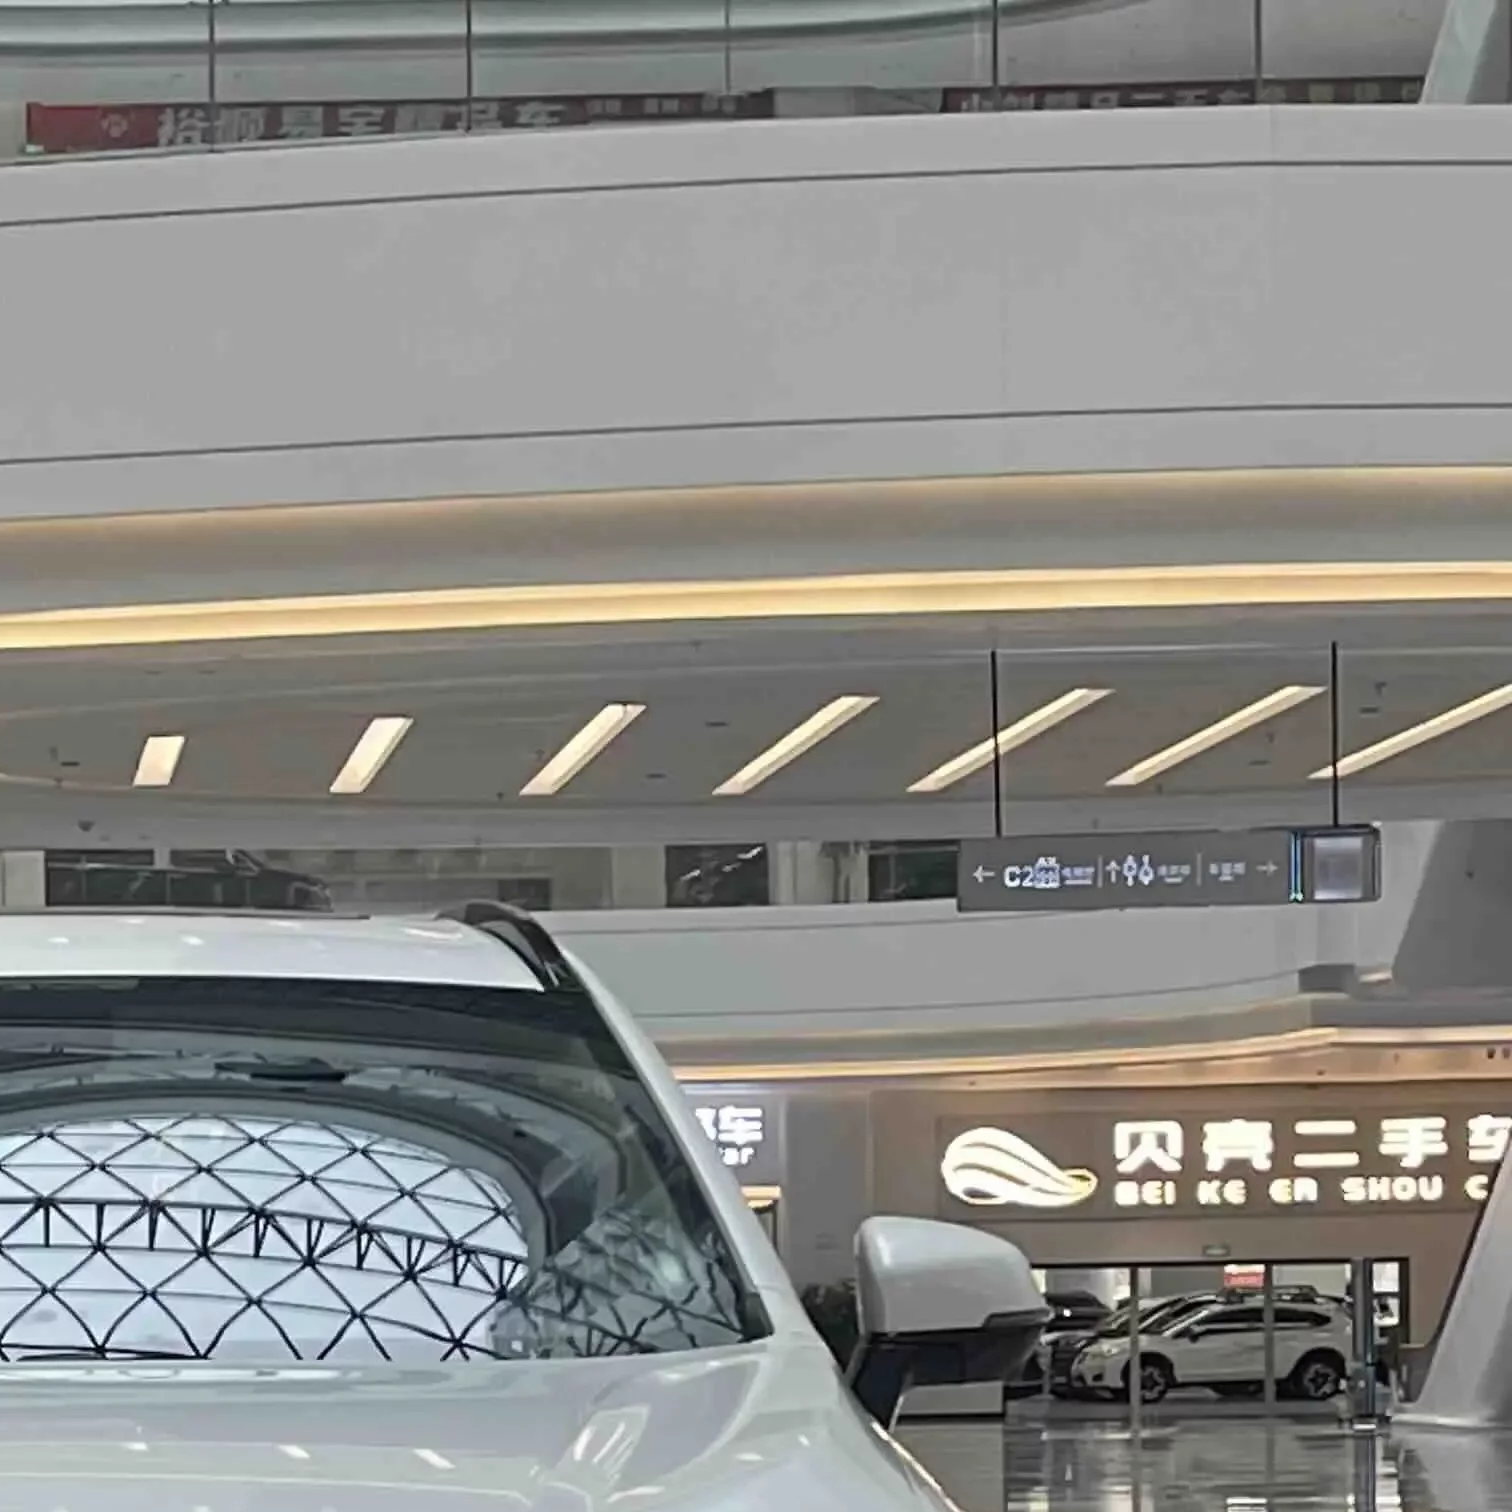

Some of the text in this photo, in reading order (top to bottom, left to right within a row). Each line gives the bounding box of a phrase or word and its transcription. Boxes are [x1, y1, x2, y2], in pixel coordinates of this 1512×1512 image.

[1114, 1180, 1177, 1206] BEI
[1196, 1179, 1247, 1205] KE
[1340, 1175, 1444, 1202] SHOU
